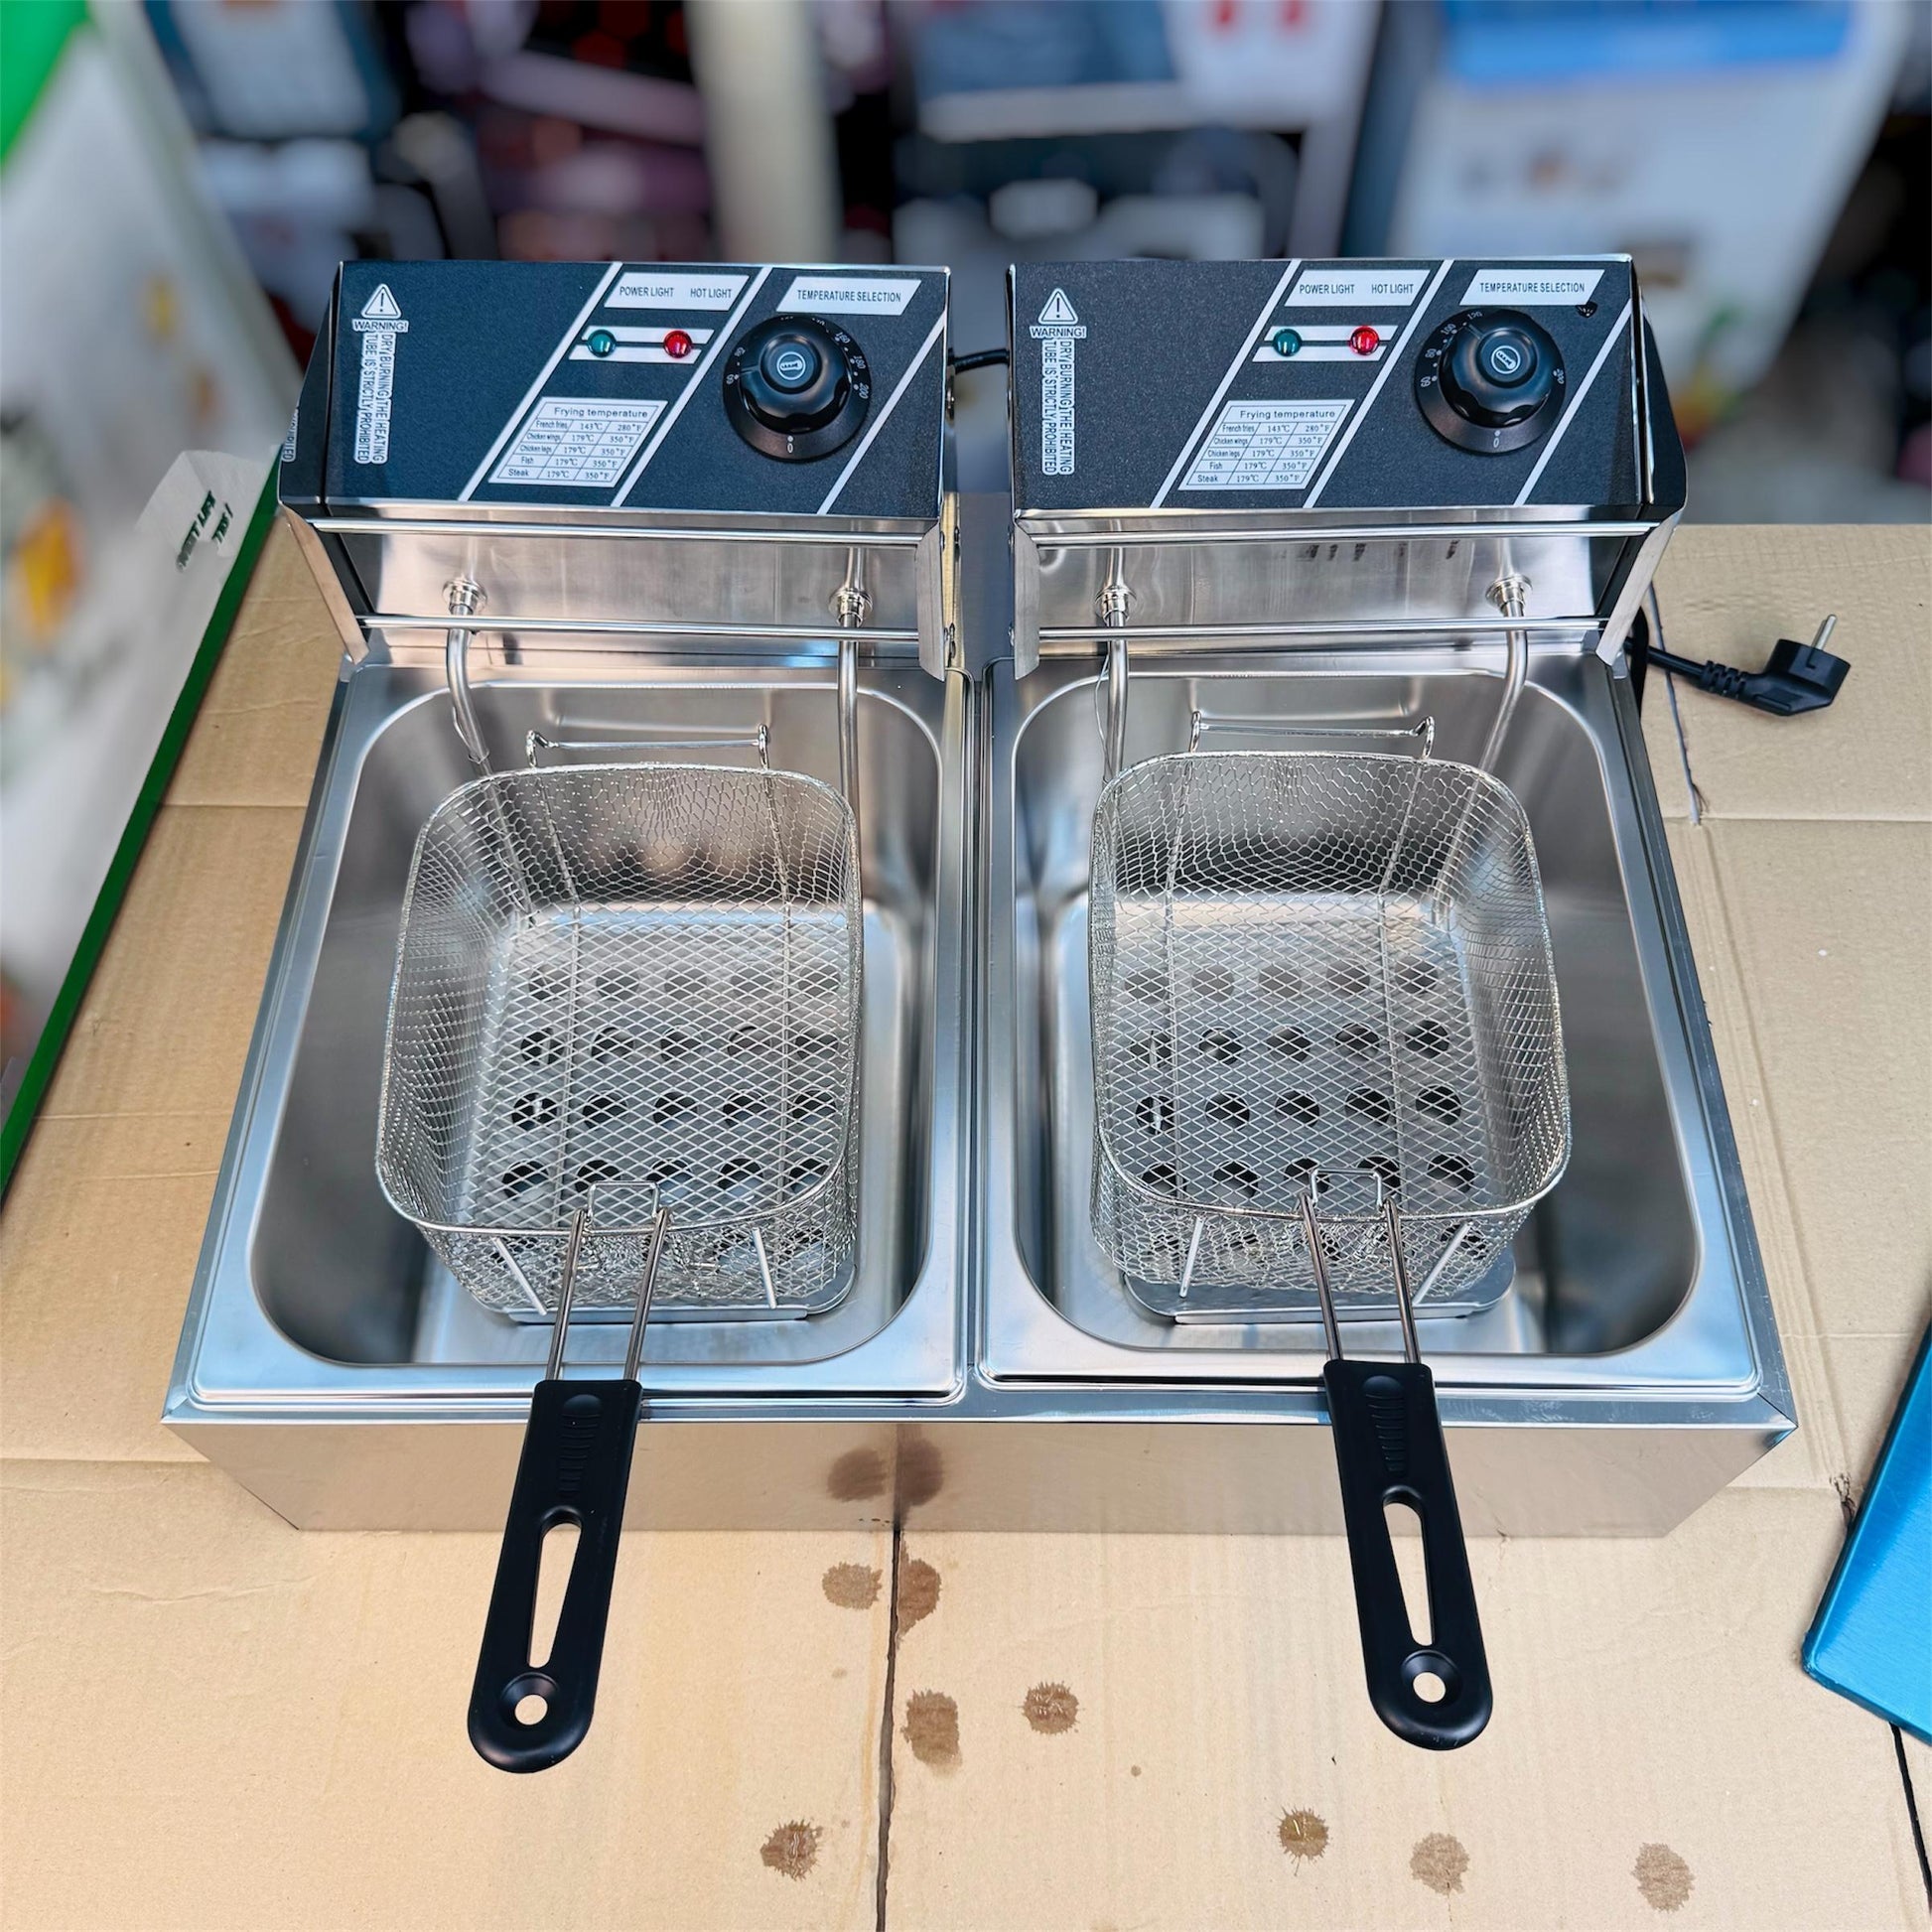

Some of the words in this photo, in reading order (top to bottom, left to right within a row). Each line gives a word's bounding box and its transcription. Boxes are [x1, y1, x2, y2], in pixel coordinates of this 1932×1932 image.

[619, 286, 649, 297] POWER
[650, 287, 674, 298] LIGHT
[690, 288, 708, 299] HOT
[708, 288, 732, 299] LIGHT
[1300, 284, 1330, 295] POWER
[1331, 284, 1355, 295] LIGHT
[1371, 283, 1389, 294] HOT
[1390, 283, 1414, 294] LIGHT
[1480, 282, 1538, 293] TEMPERATURE
[1540, 282, 1586, 293] SELECTION
[797, 289, 855, 302] TEMPERATURE
[857, 291, 901, 303] SELECTION
[354, 321, 408, 332] WARNING!
[1031, 327, 1085, 339] WARNING!
[365, 334, 378, 355] TUBE
[380, 334, 394, 354] DRY
[1059, 341, 1072, 361] DRY
[1044, 341, 1057, 362] TUBE
[363, 357, 376, 367] IS
[377, 355, 392, 400] BURNING
[1044, 366, 1057, 375] IS
[361, 370, 375, 408] STRICTLY
[859, 382, 869, 399] 200
[1059, 363, 1072, 406] BURNING
[1044, 379, 1057, 419] STRICTLY
[375, 401, 389, 418] THE
[554, 407, 585, 417] Frying
[588, 408, 648, 418] temperature
[1240, 410, 1271, 420] Frying
[1274, 410, 1335, 419] temperature
[536, 420, 555, 429] French
[1059, 410, 1072, 429] THE
[357, 412, 373, 462] PROHIBITED
[372, 422, 388, 462] HEATING
[1235, 437, 1248, 446] wings
[1493, 437, 1499, 448] 0
[787, 443, 793, 454] 0
[1044, 422, 1057, 474] PROHIBITED
[1059, 433, 1072, 473] HEATING
